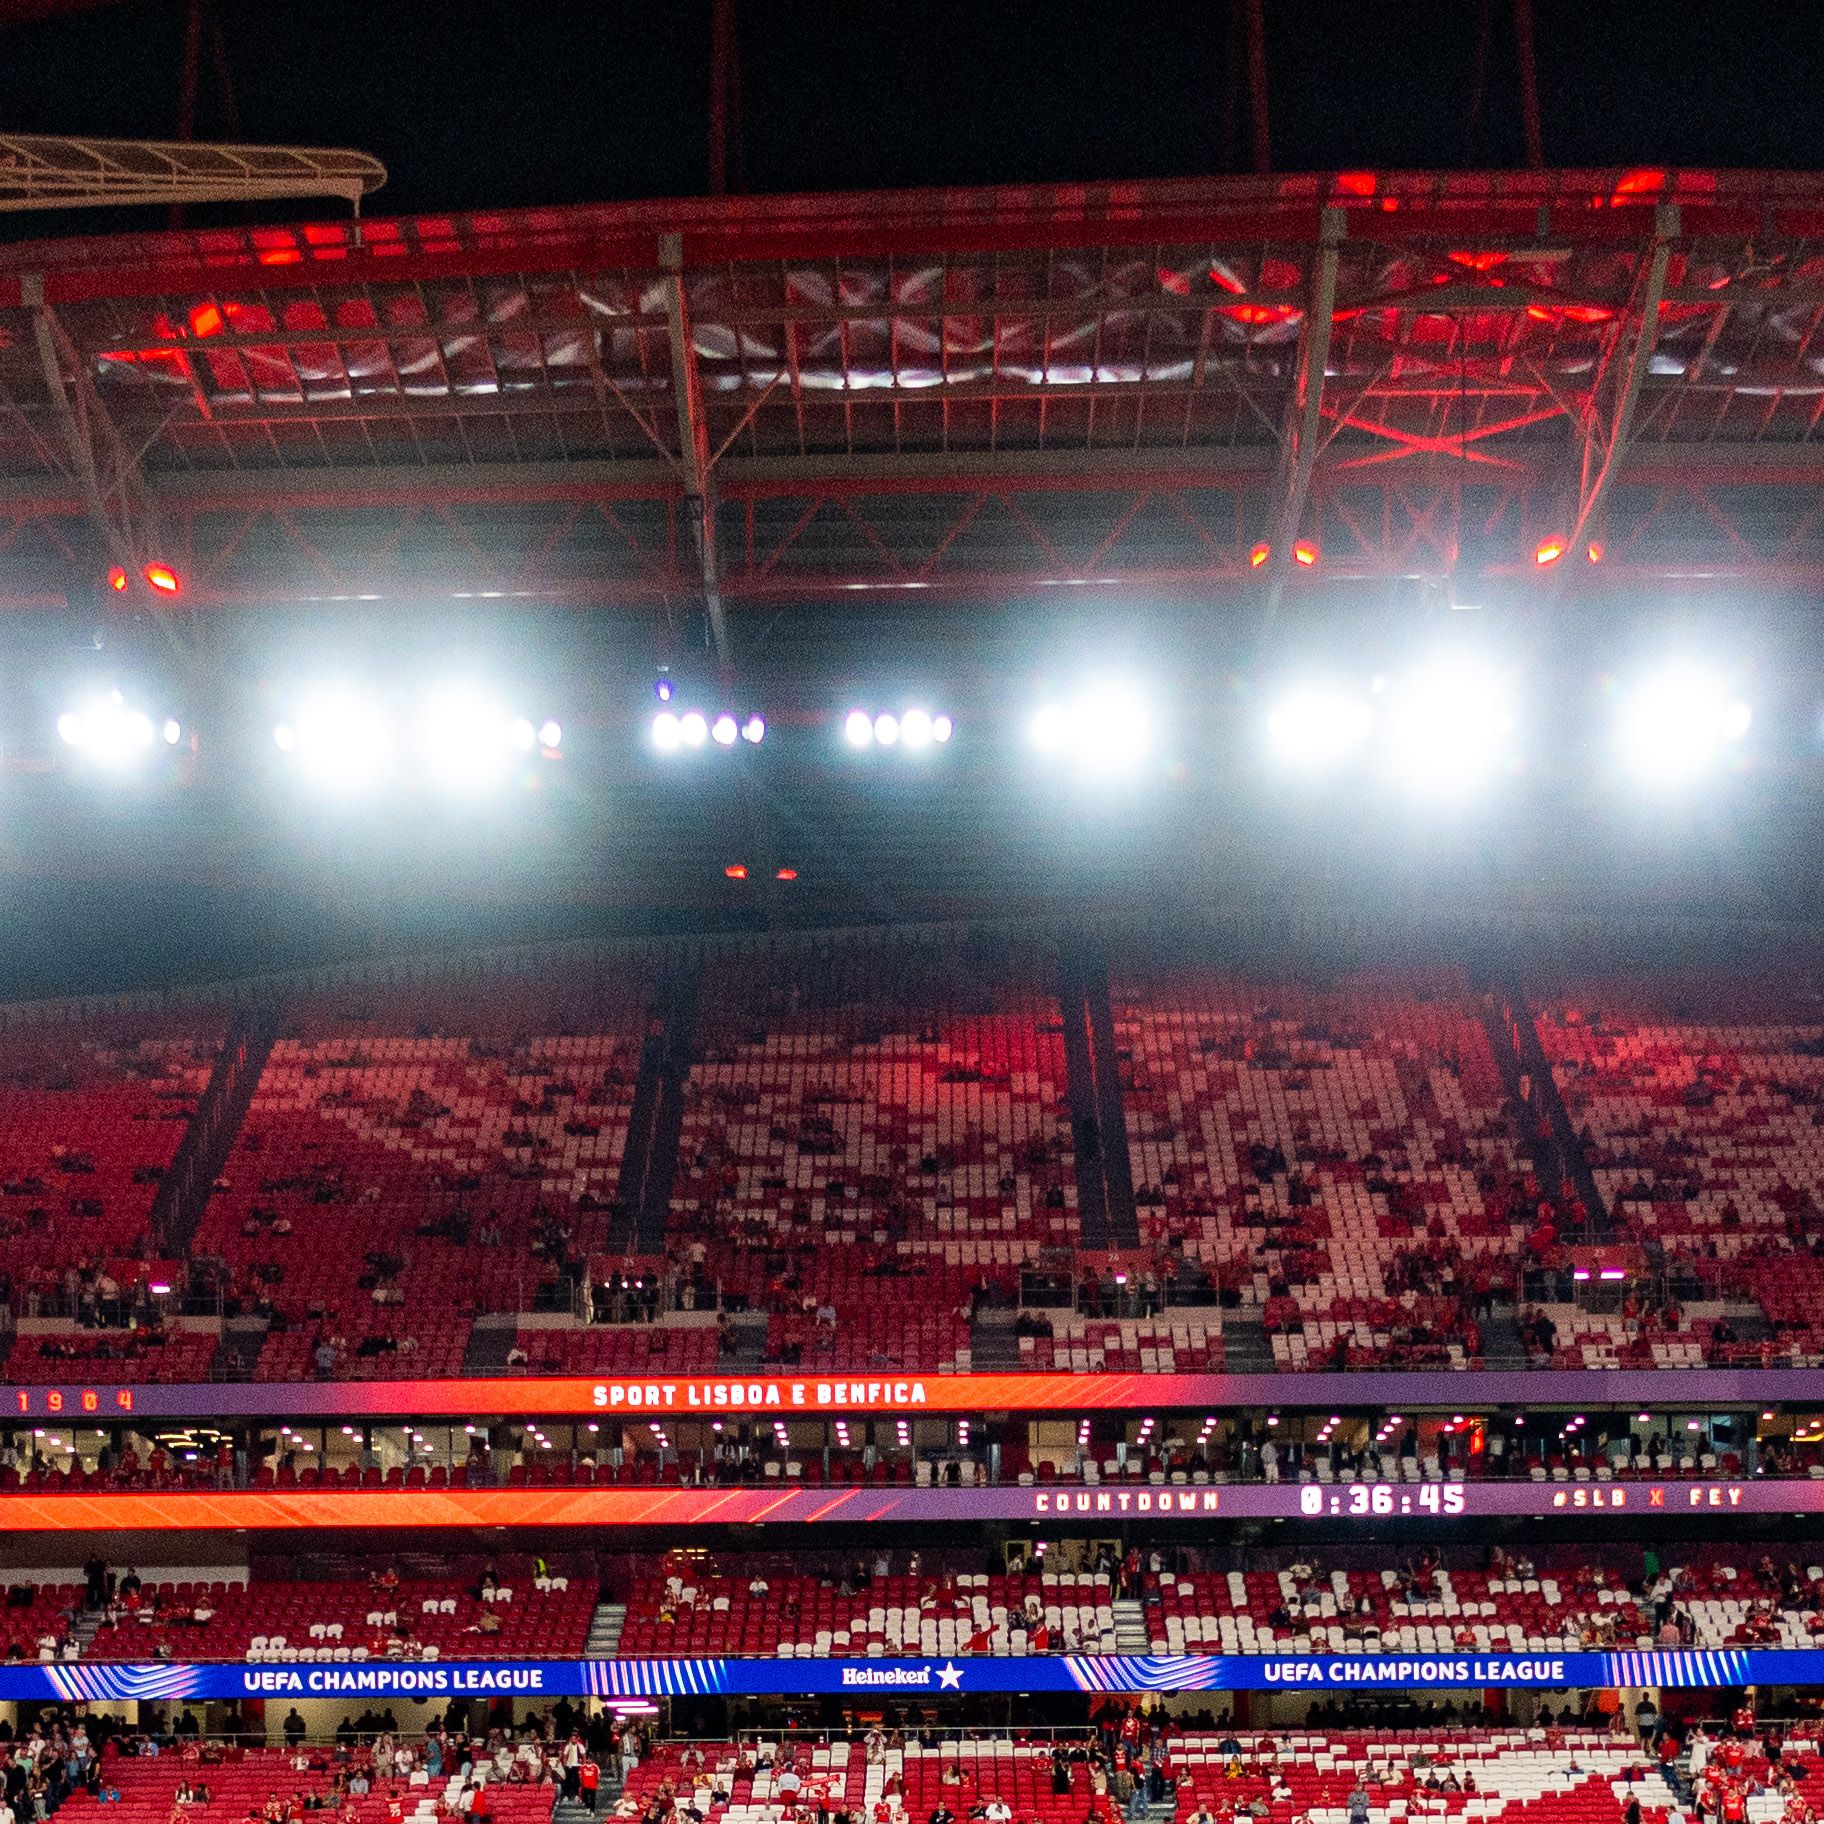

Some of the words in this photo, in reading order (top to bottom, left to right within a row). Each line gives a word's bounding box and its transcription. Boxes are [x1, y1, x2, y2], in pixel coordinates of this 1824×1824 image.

[593, 1385, 677, 1406] SPORT
[688, 1384, 780, 1406] LISBOA
[791, 1383, 805, 1405] E
[817, 1382, 926, 1405] BENFICA
[1036, 1492, 1219, 1511] COUNTDOWN
[1300, 1483, 1465, 1515] 0:36:45
[1690, 1488, 1743, 1506] FEY
[244, 1671, 304, 1691] UEFA
[308, 1670, 448, 1691] CHAMPIONS
[453, 1669, 543, 1689] LEAGUE
[843, 1667, 930, 1685] Heineken
[1264, 1662, 1324, 1682] UEFA
[1328, 1661, 1469, 1682] CHAMPIONS
[1474, 1660, 1564, 1680] LEAGUE
